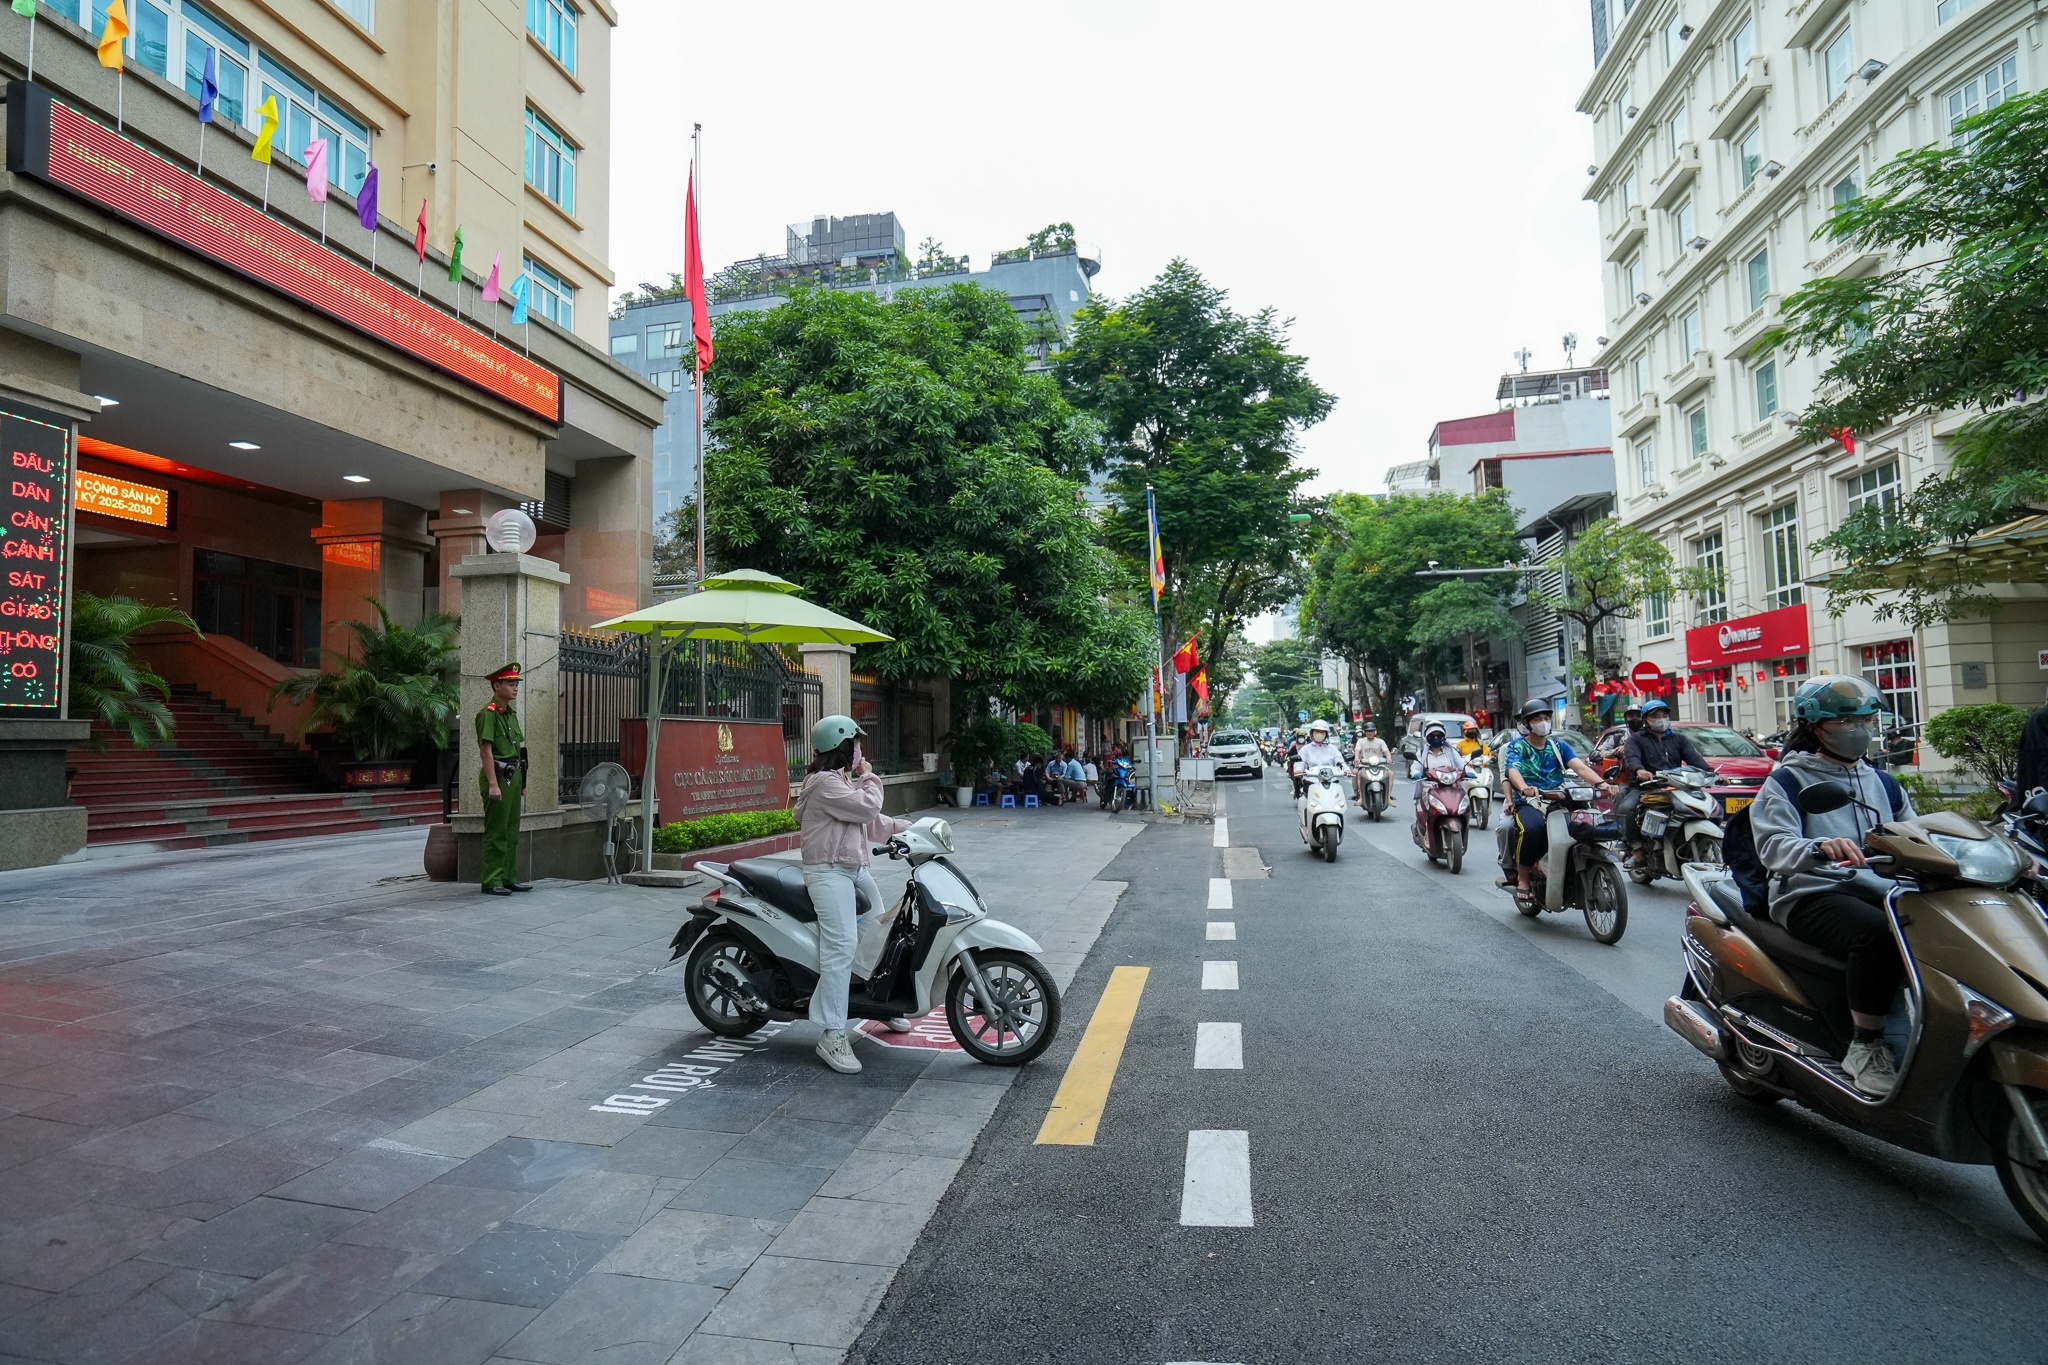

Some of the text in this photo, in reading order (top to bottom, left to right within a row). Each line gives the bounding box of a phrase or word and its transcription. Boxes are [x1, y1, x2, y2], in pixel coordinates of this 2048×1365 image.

[13, 452, 50, 472] ĐÂU
[12, 481, 50, 502] DÂN
[84, 480, 118, 496] CỘNG
[121, 488, 144, 501] SẢN
[99, 496, 153, 516] 2025-2030
[4, 538, 54, 562] CẢNH
[9, 571, 45, 589] SÁT
[1, 601, 51, 619] GIAO
[0, 630, 55, 649] THÔNG
[589, 1094, 671, 1116] ĐI
